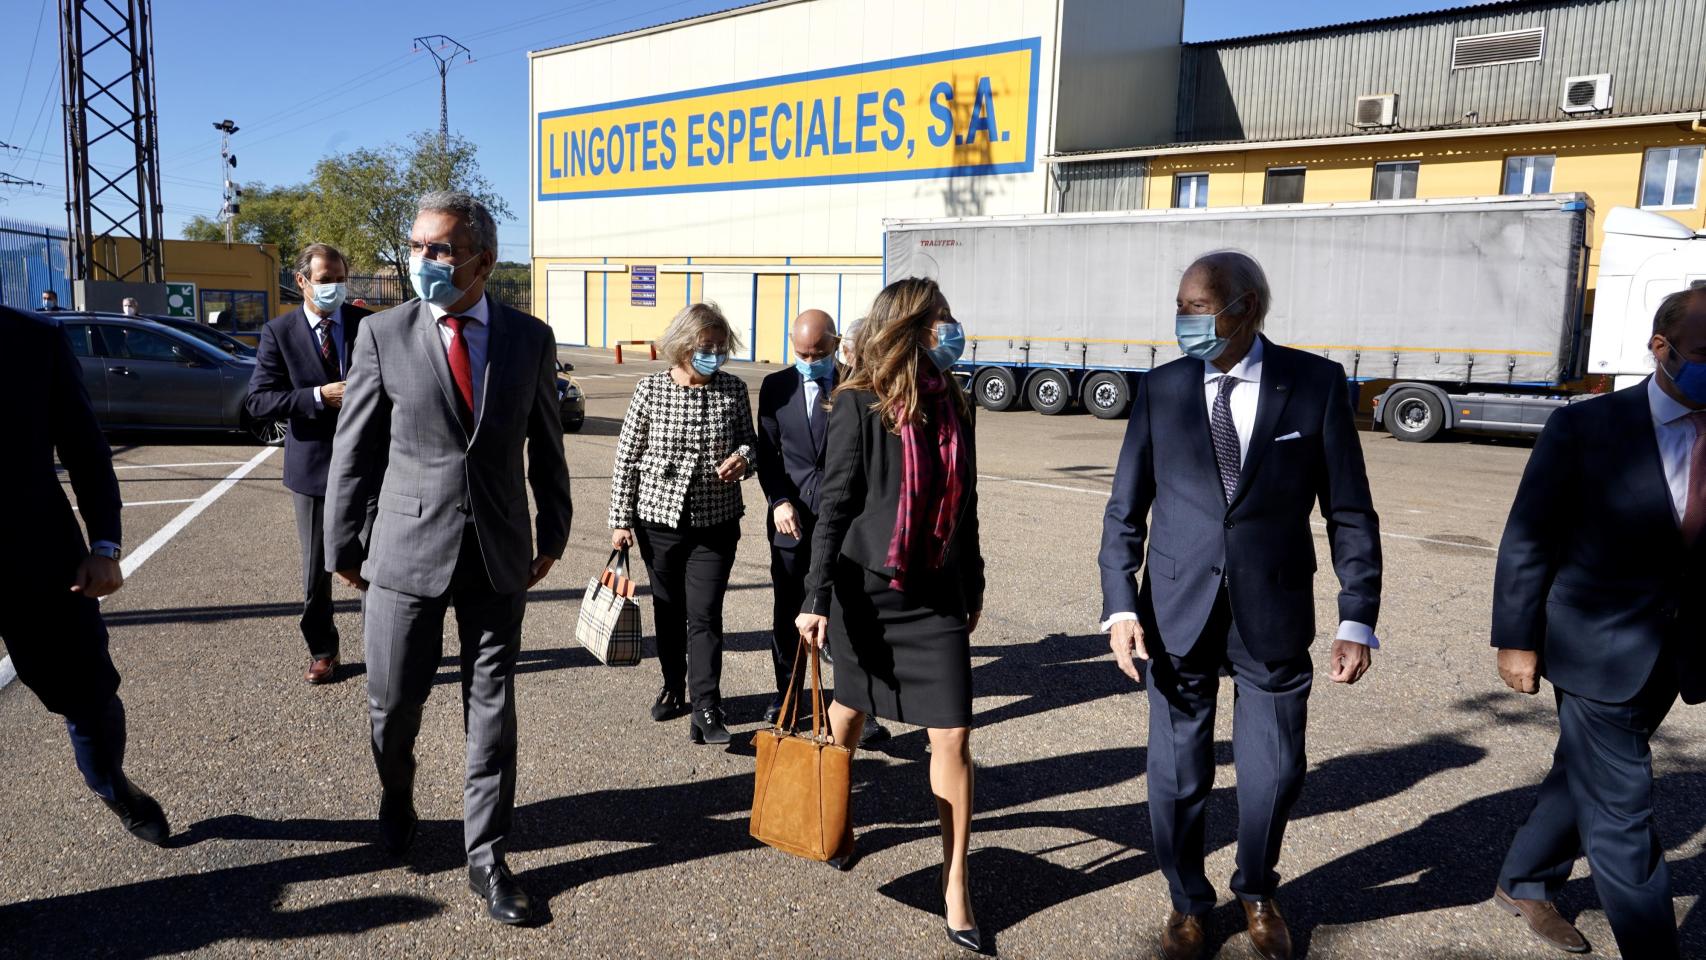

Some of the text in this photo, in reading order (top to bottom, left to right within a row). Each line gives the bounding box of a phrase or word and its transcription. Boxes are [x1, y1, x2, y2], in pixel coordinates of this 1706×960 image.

[549, 76, 1011, 179] LINGOTES ESPECIALES, S.A.
